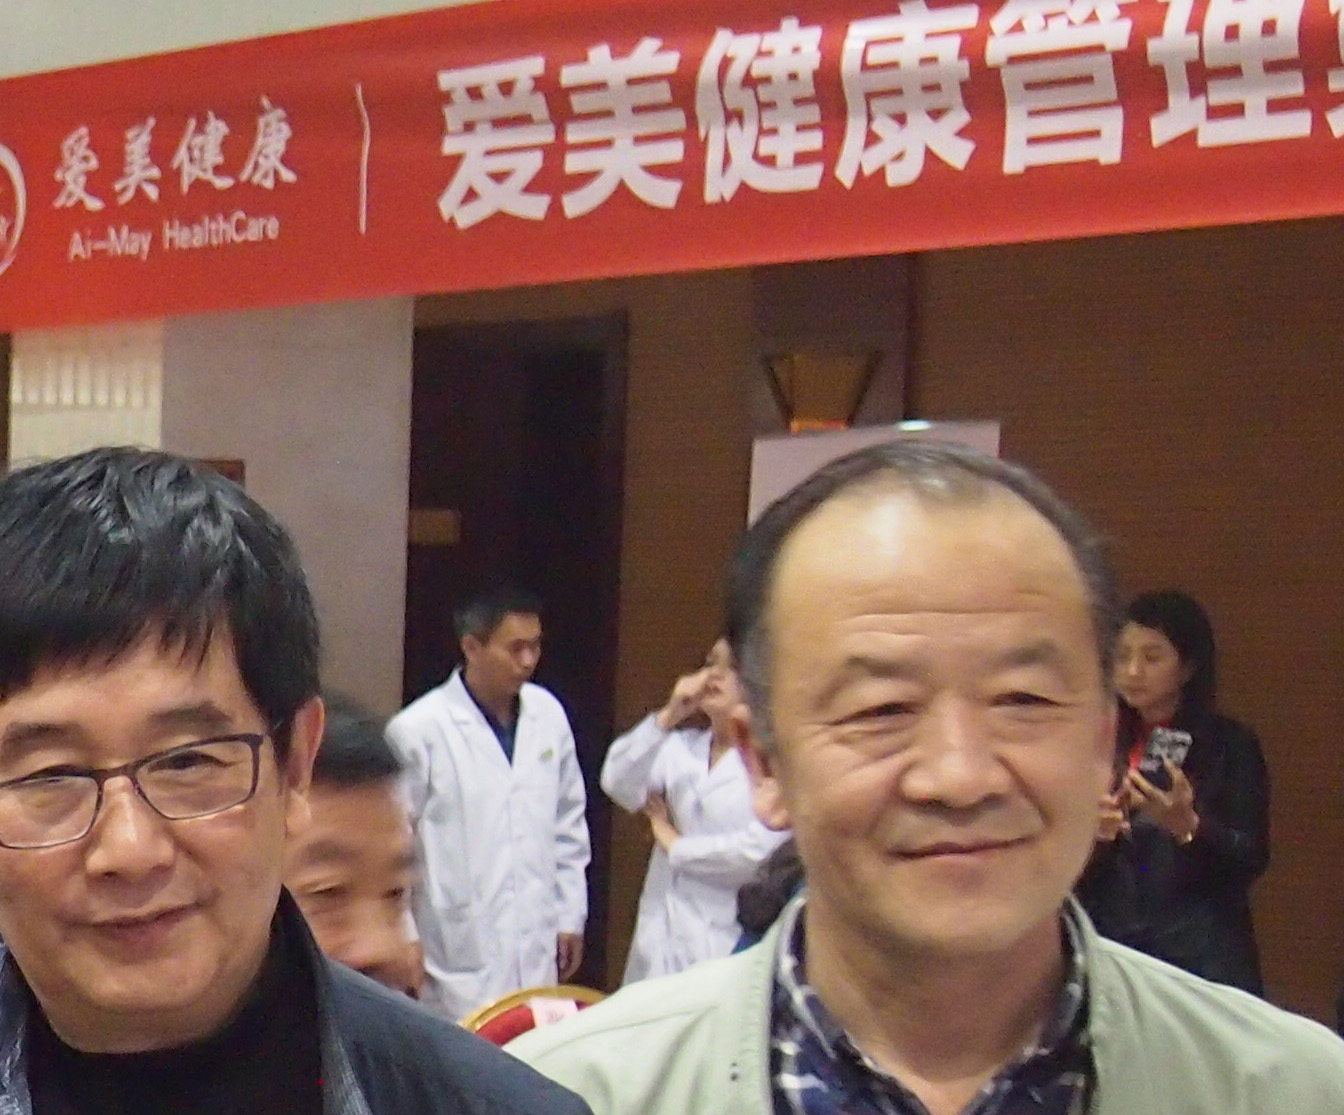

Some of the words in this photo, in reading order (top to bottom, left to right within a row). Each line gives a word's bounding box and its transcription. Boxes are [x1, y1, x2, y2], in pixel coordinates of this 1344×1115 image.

[53, 95, 298, 211] 爱美健康
[436, 0, 1344, 230] 爱美健康管理
[68, 224, 153, 262] Ai-May
[163, 210, 280, 250] HealthCare
